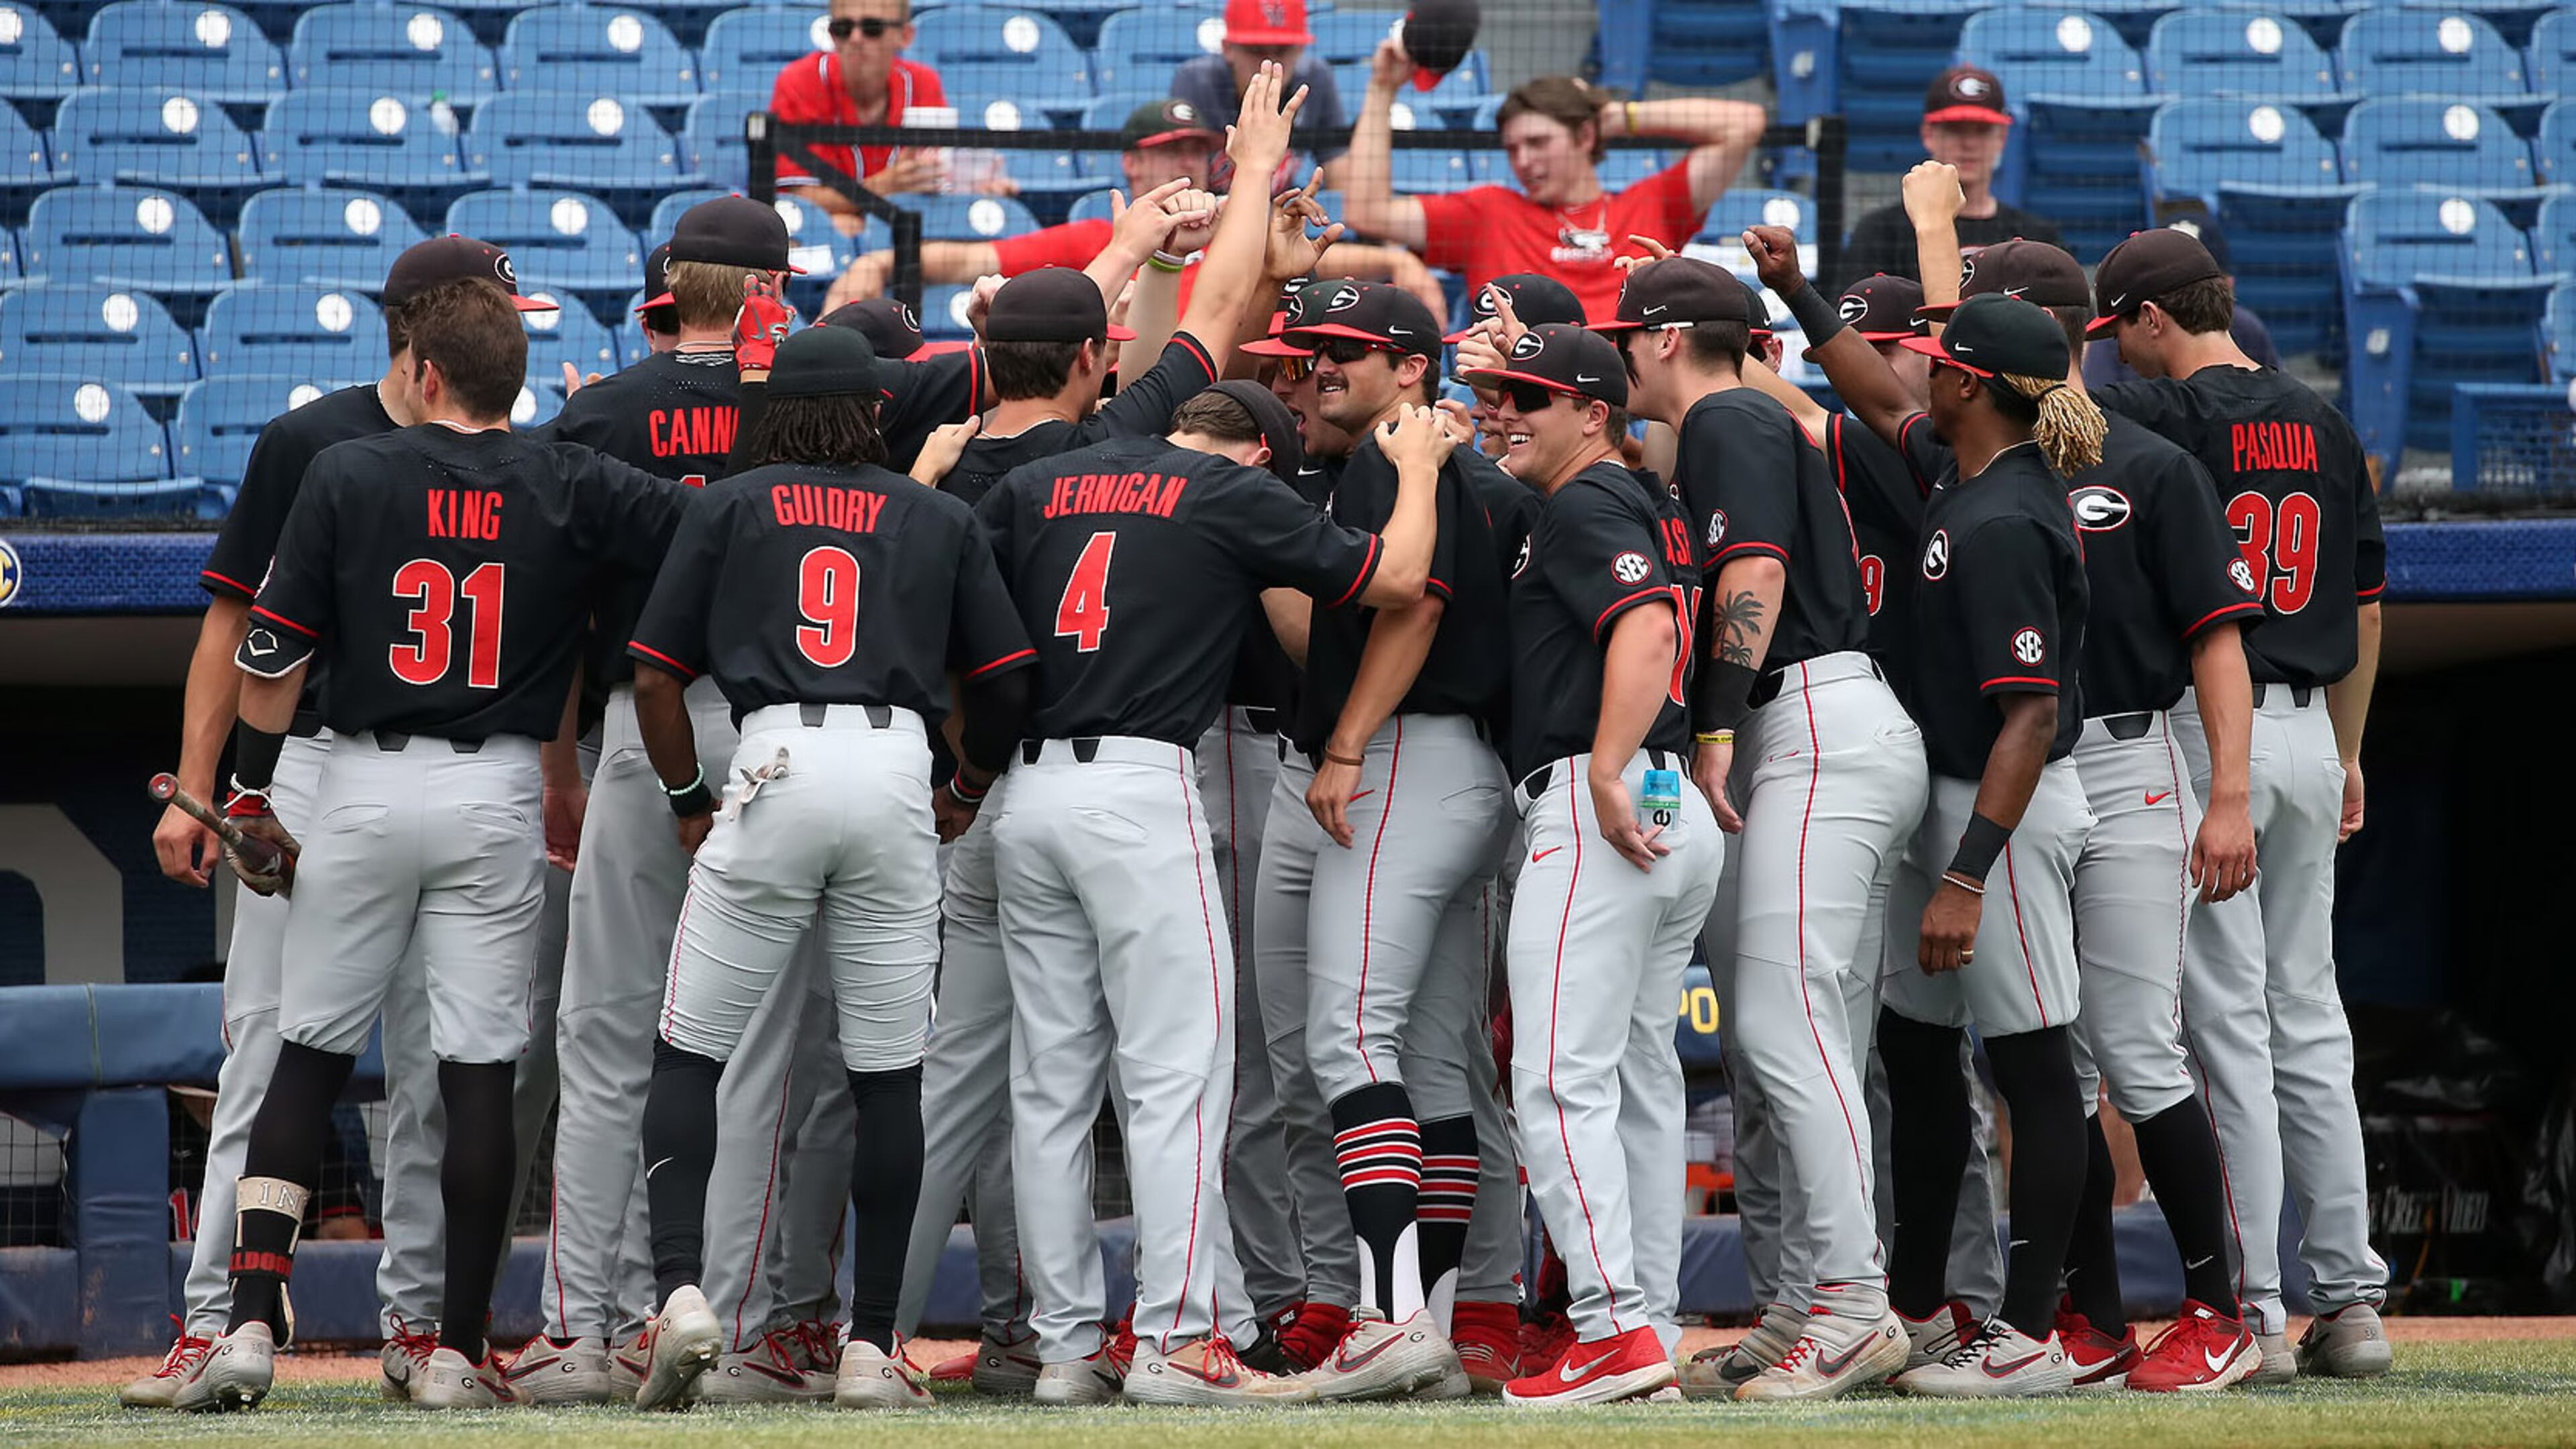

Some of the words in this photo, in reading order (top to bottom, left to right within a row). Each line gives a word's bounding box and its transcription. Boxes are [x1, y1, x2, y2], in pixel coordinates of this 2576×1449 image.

[2232, 422, 2318, 472] PASQUA
[427, 489, 503, 541] KING
[771, 484, 888, 533] GUIDRY
[1044, 472, 1187, 519] JERNIGAN
[2073, 491, 2130, 526] G
[1614, 553, 1650, 583] SEC
[2225, 491, 2321, 614] 39
[796, 545, 860, 667] 9
[1054, 531, 1116, 653] 4
[389, 558, 504, 689] 31
[2015, 630, 2044, 663] SEC
